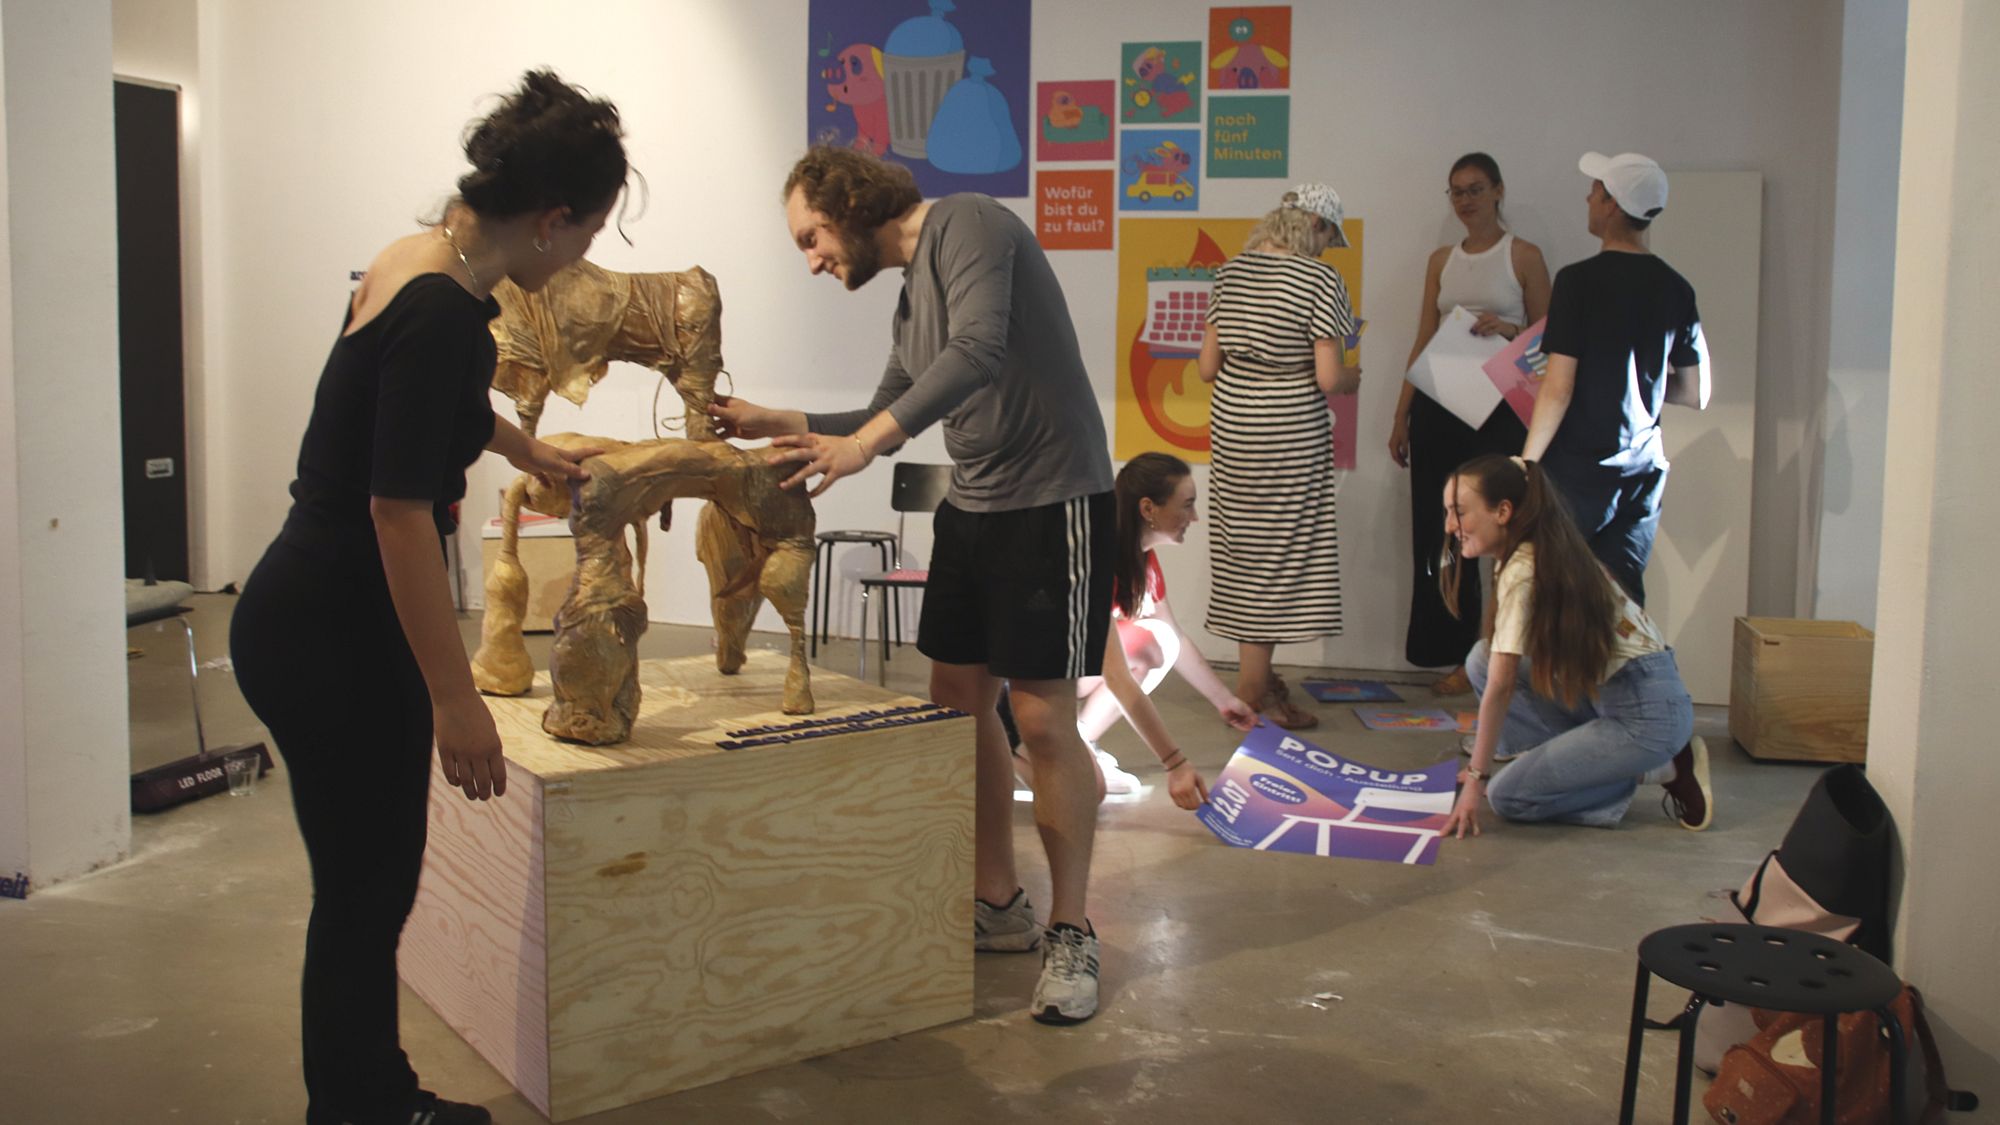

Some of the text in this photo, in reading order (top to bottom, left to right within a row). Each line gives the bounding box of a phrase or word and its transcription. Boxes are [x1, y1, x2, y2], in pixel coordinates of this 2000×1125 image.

[1215, 113, 1256, 126] noch
[1215, 129, 1249, 143] fünf
[1215, 147, 1283, 160] Minuten
[1045, 186, 1094, 199] Wofür
[1044, 203, 1098, 216] bist du
[1044, 219, 1105, 233] zu faul?
[1275, 749, 1303, 764] Setz
[1304, 763, 1334, 777] dich
[1278, 736, 1428, 786] POPUP
[178, 767, 225, 790] LED FLOOR
[1212, 778, 1251, 825] 12.07
